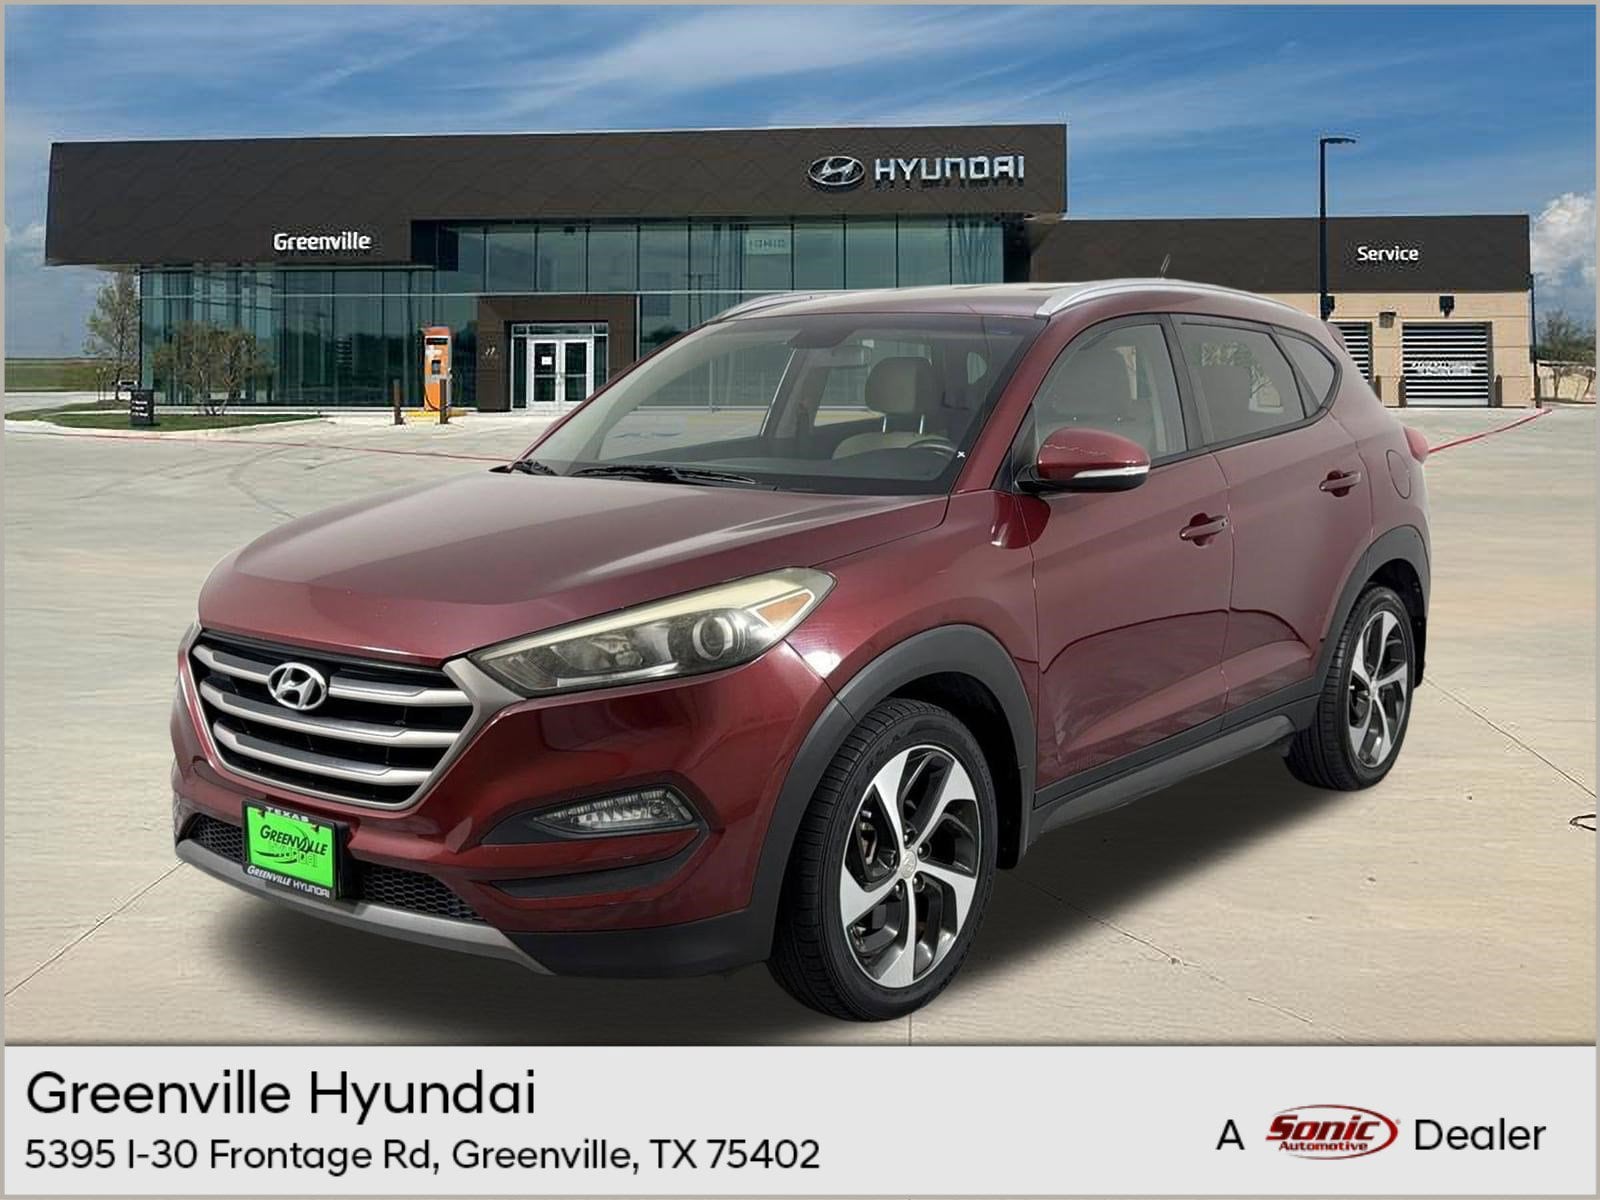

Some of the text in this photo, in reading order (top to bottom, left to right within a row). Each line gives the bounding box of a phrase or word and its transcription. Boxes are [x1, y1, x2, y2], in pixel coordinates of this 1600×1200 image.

[875, 155, 1025, 181] HYUNDAI
[273, 231, 371, 251] Greenville
[1357, 245, 1419, 261] Service
[260, 824, 328, 856] GREENVILLE
[247, 865, 330, 898] GREENVILLE HYUNDAI
